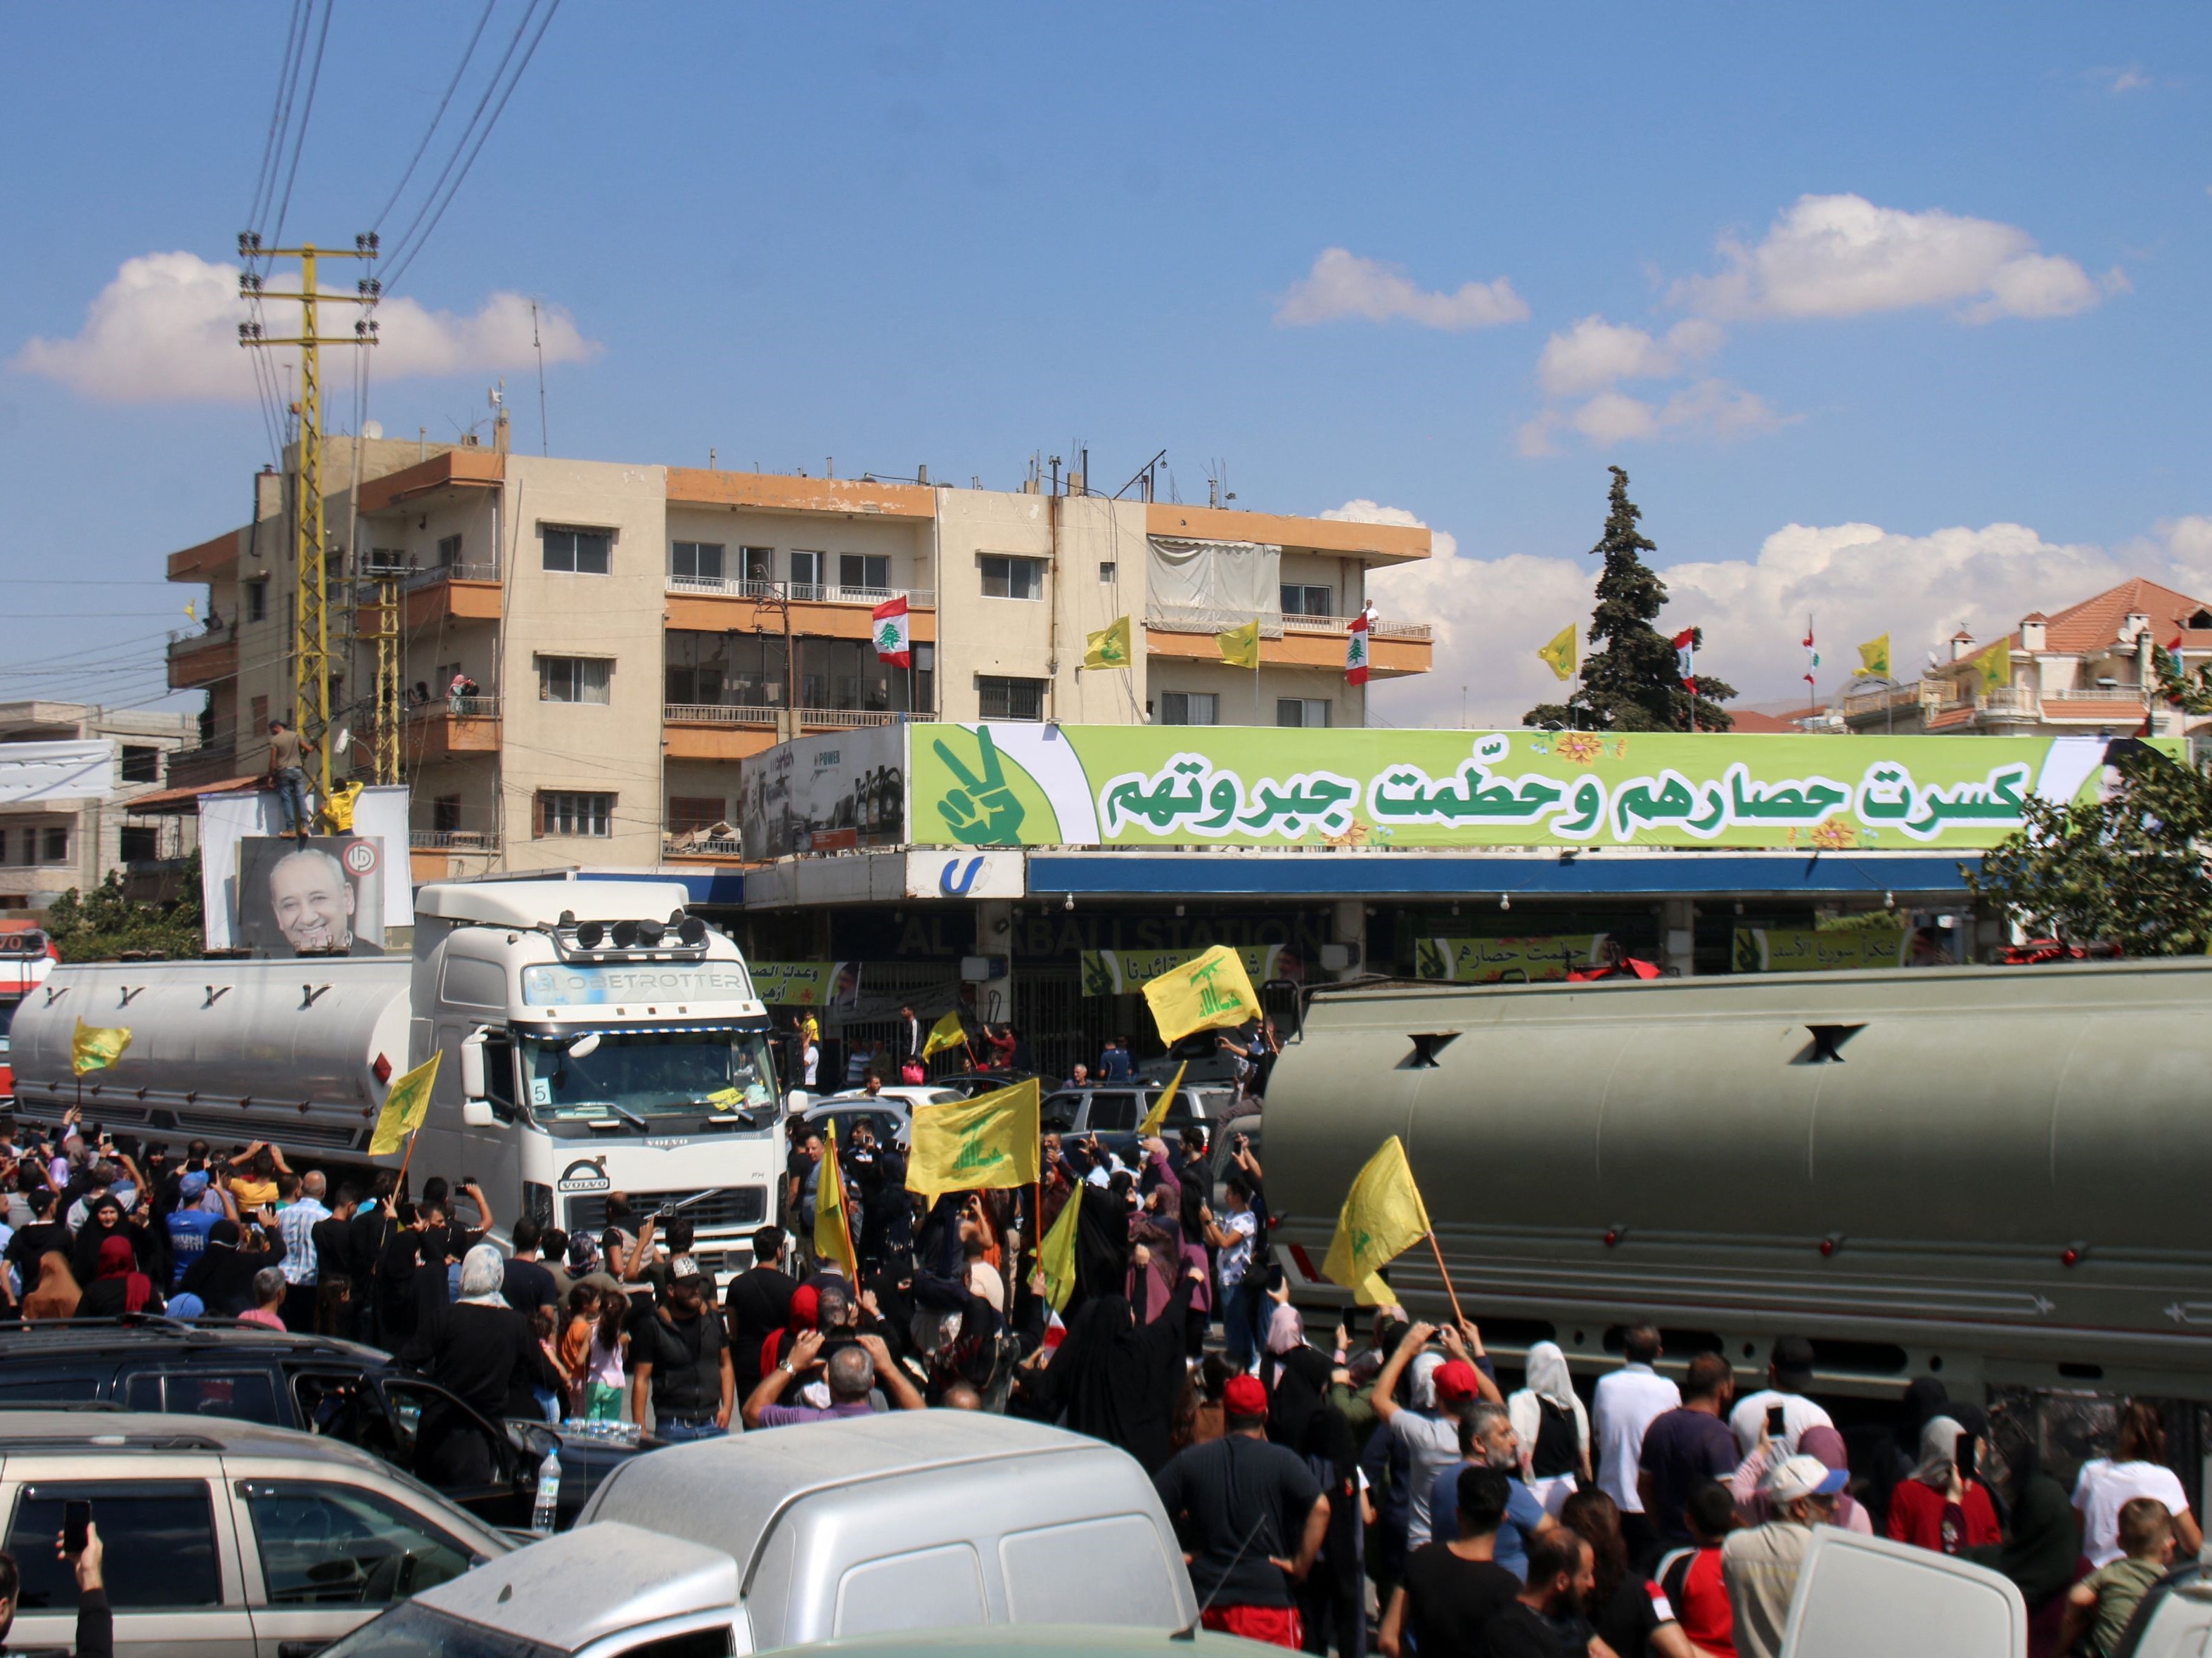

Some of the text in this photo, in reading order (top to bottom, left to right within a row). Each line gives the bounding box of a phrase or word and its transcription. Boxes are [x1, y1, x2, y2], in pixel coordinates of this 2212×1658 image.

[1107, 761, 1352, 831] جبروتهم
[1618, 771, 1846, 833] حصارهم
[1864, 770, 2024, 832] كسرت
[535, 1085, 546, 1102] 5
[647, 1138, 689, 1147] VOLVO
[563, 1181, 606, 1189] VOLVO
